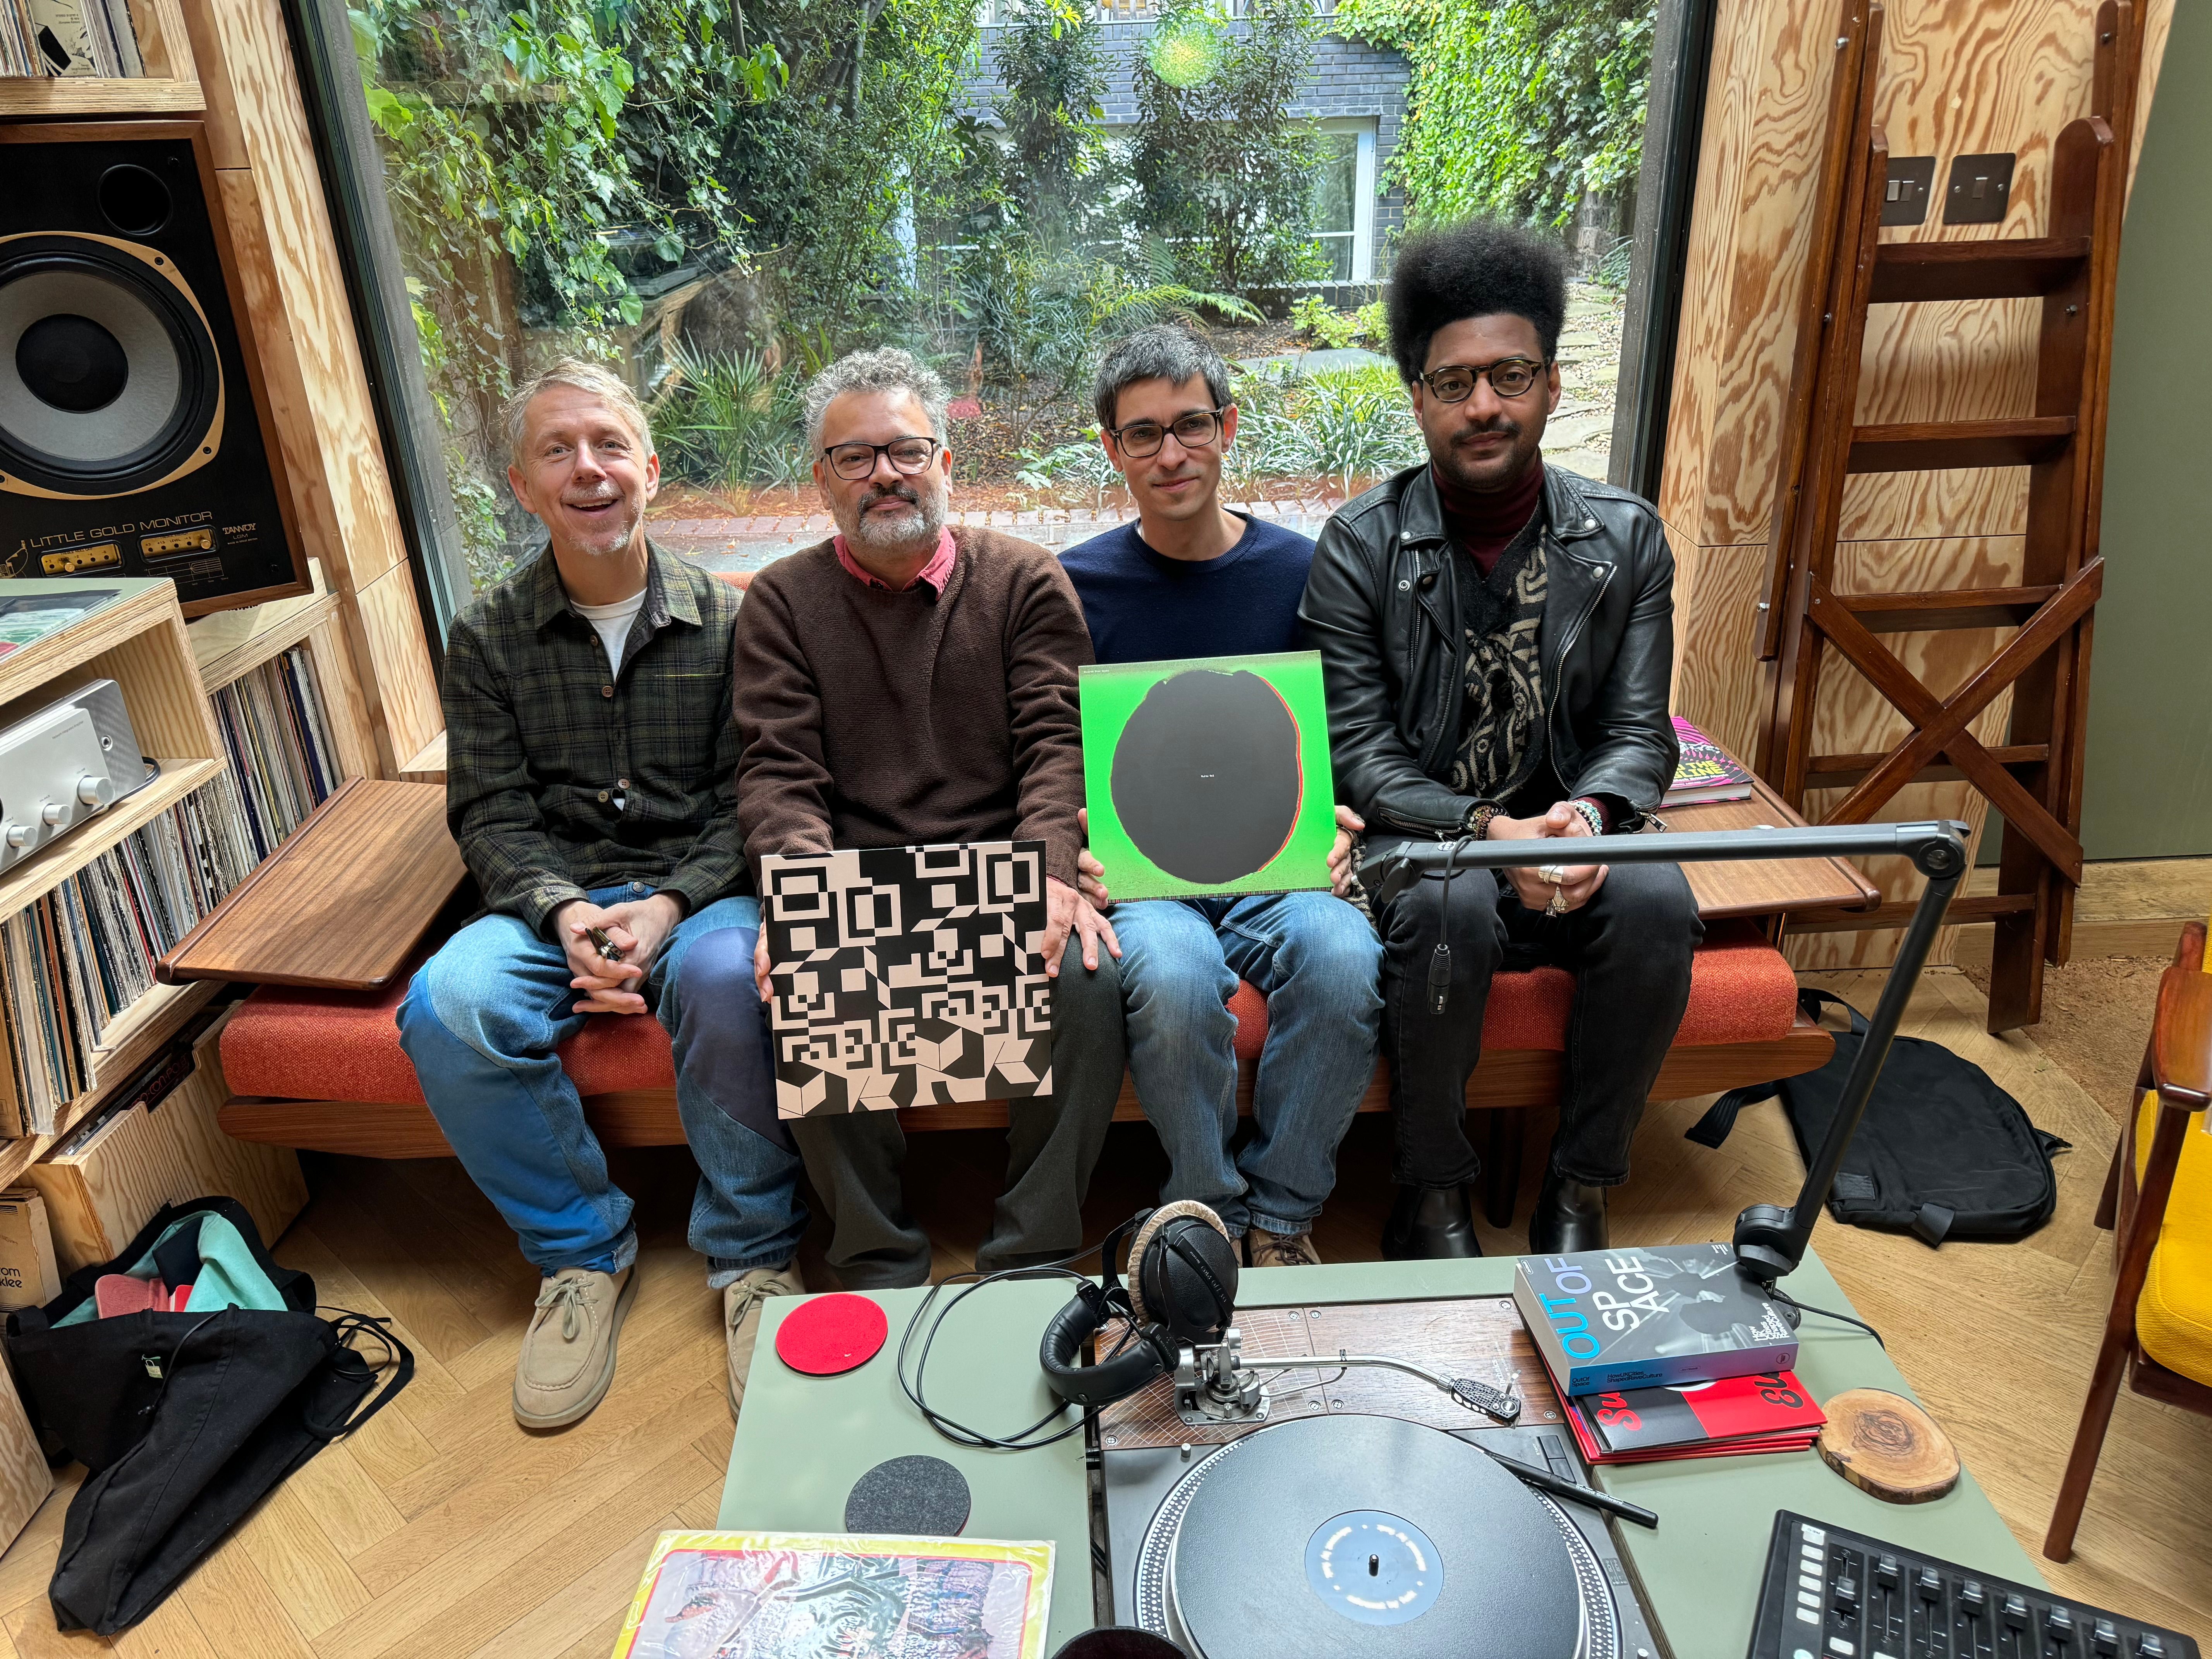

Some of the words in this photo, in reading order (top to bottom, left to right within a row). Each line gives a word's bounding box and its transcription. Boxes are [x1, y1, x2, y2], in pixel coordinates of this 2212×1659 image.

[31, 531, 85, 548] LITTLE
[90, 524, 135, 538] GOLD
[140, 511, 213, 530] MONITOR
[222, 523, 256, 534] TANNOY
[1685, 760, 1717, 769] THE
[1544, 1257, 1592, 1295] OF
[1539, 1293, 1600, 1359] OUT
[1576, 1485, 1595, 1494] Sound
[1596, 1492, 1623, 1505] Software
